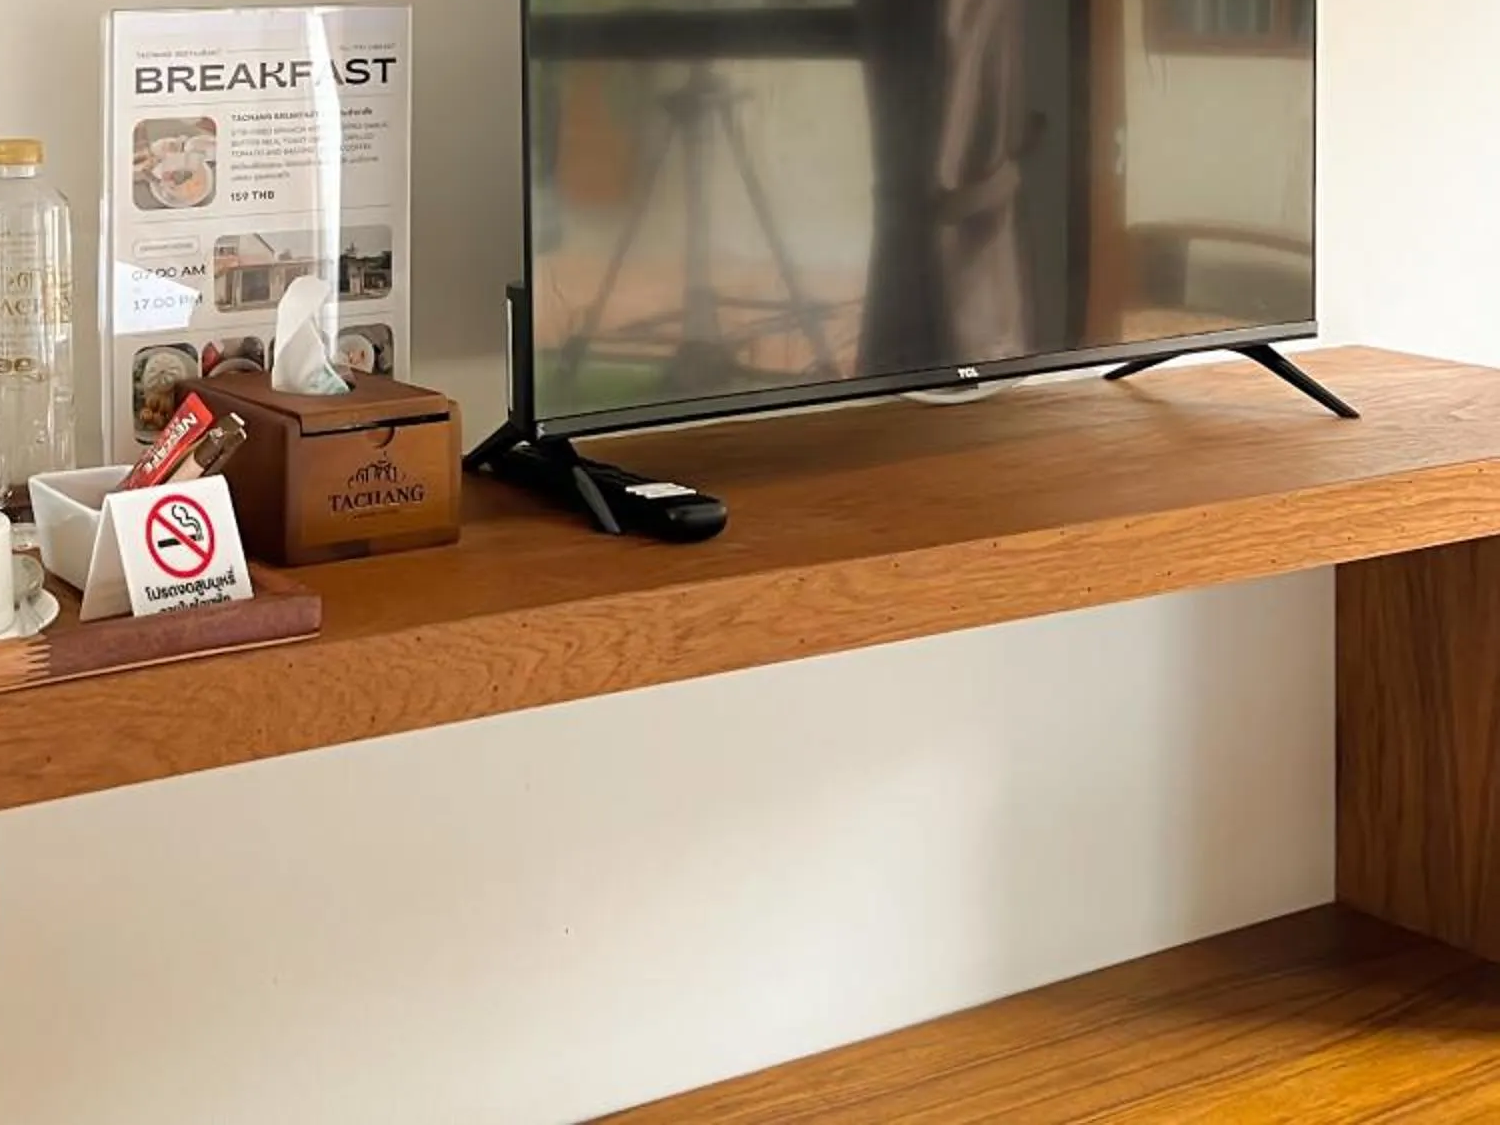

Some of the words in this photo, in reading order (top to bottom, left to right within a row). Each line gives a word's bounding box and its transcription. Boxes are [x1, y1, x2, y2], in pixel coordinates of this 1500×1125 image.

[135, 57, 397, 94] BREAKFAST
[230, 192, 249, 202] 159
[252, 190, 275, 201] THB
[181, 263, 205, 276] AM
[957, 366, 979, 379] TCL
[327, 483, 425, 512] TACHANG
[144, 563, 237, 602] โปรดงดสูบบุหรี่
